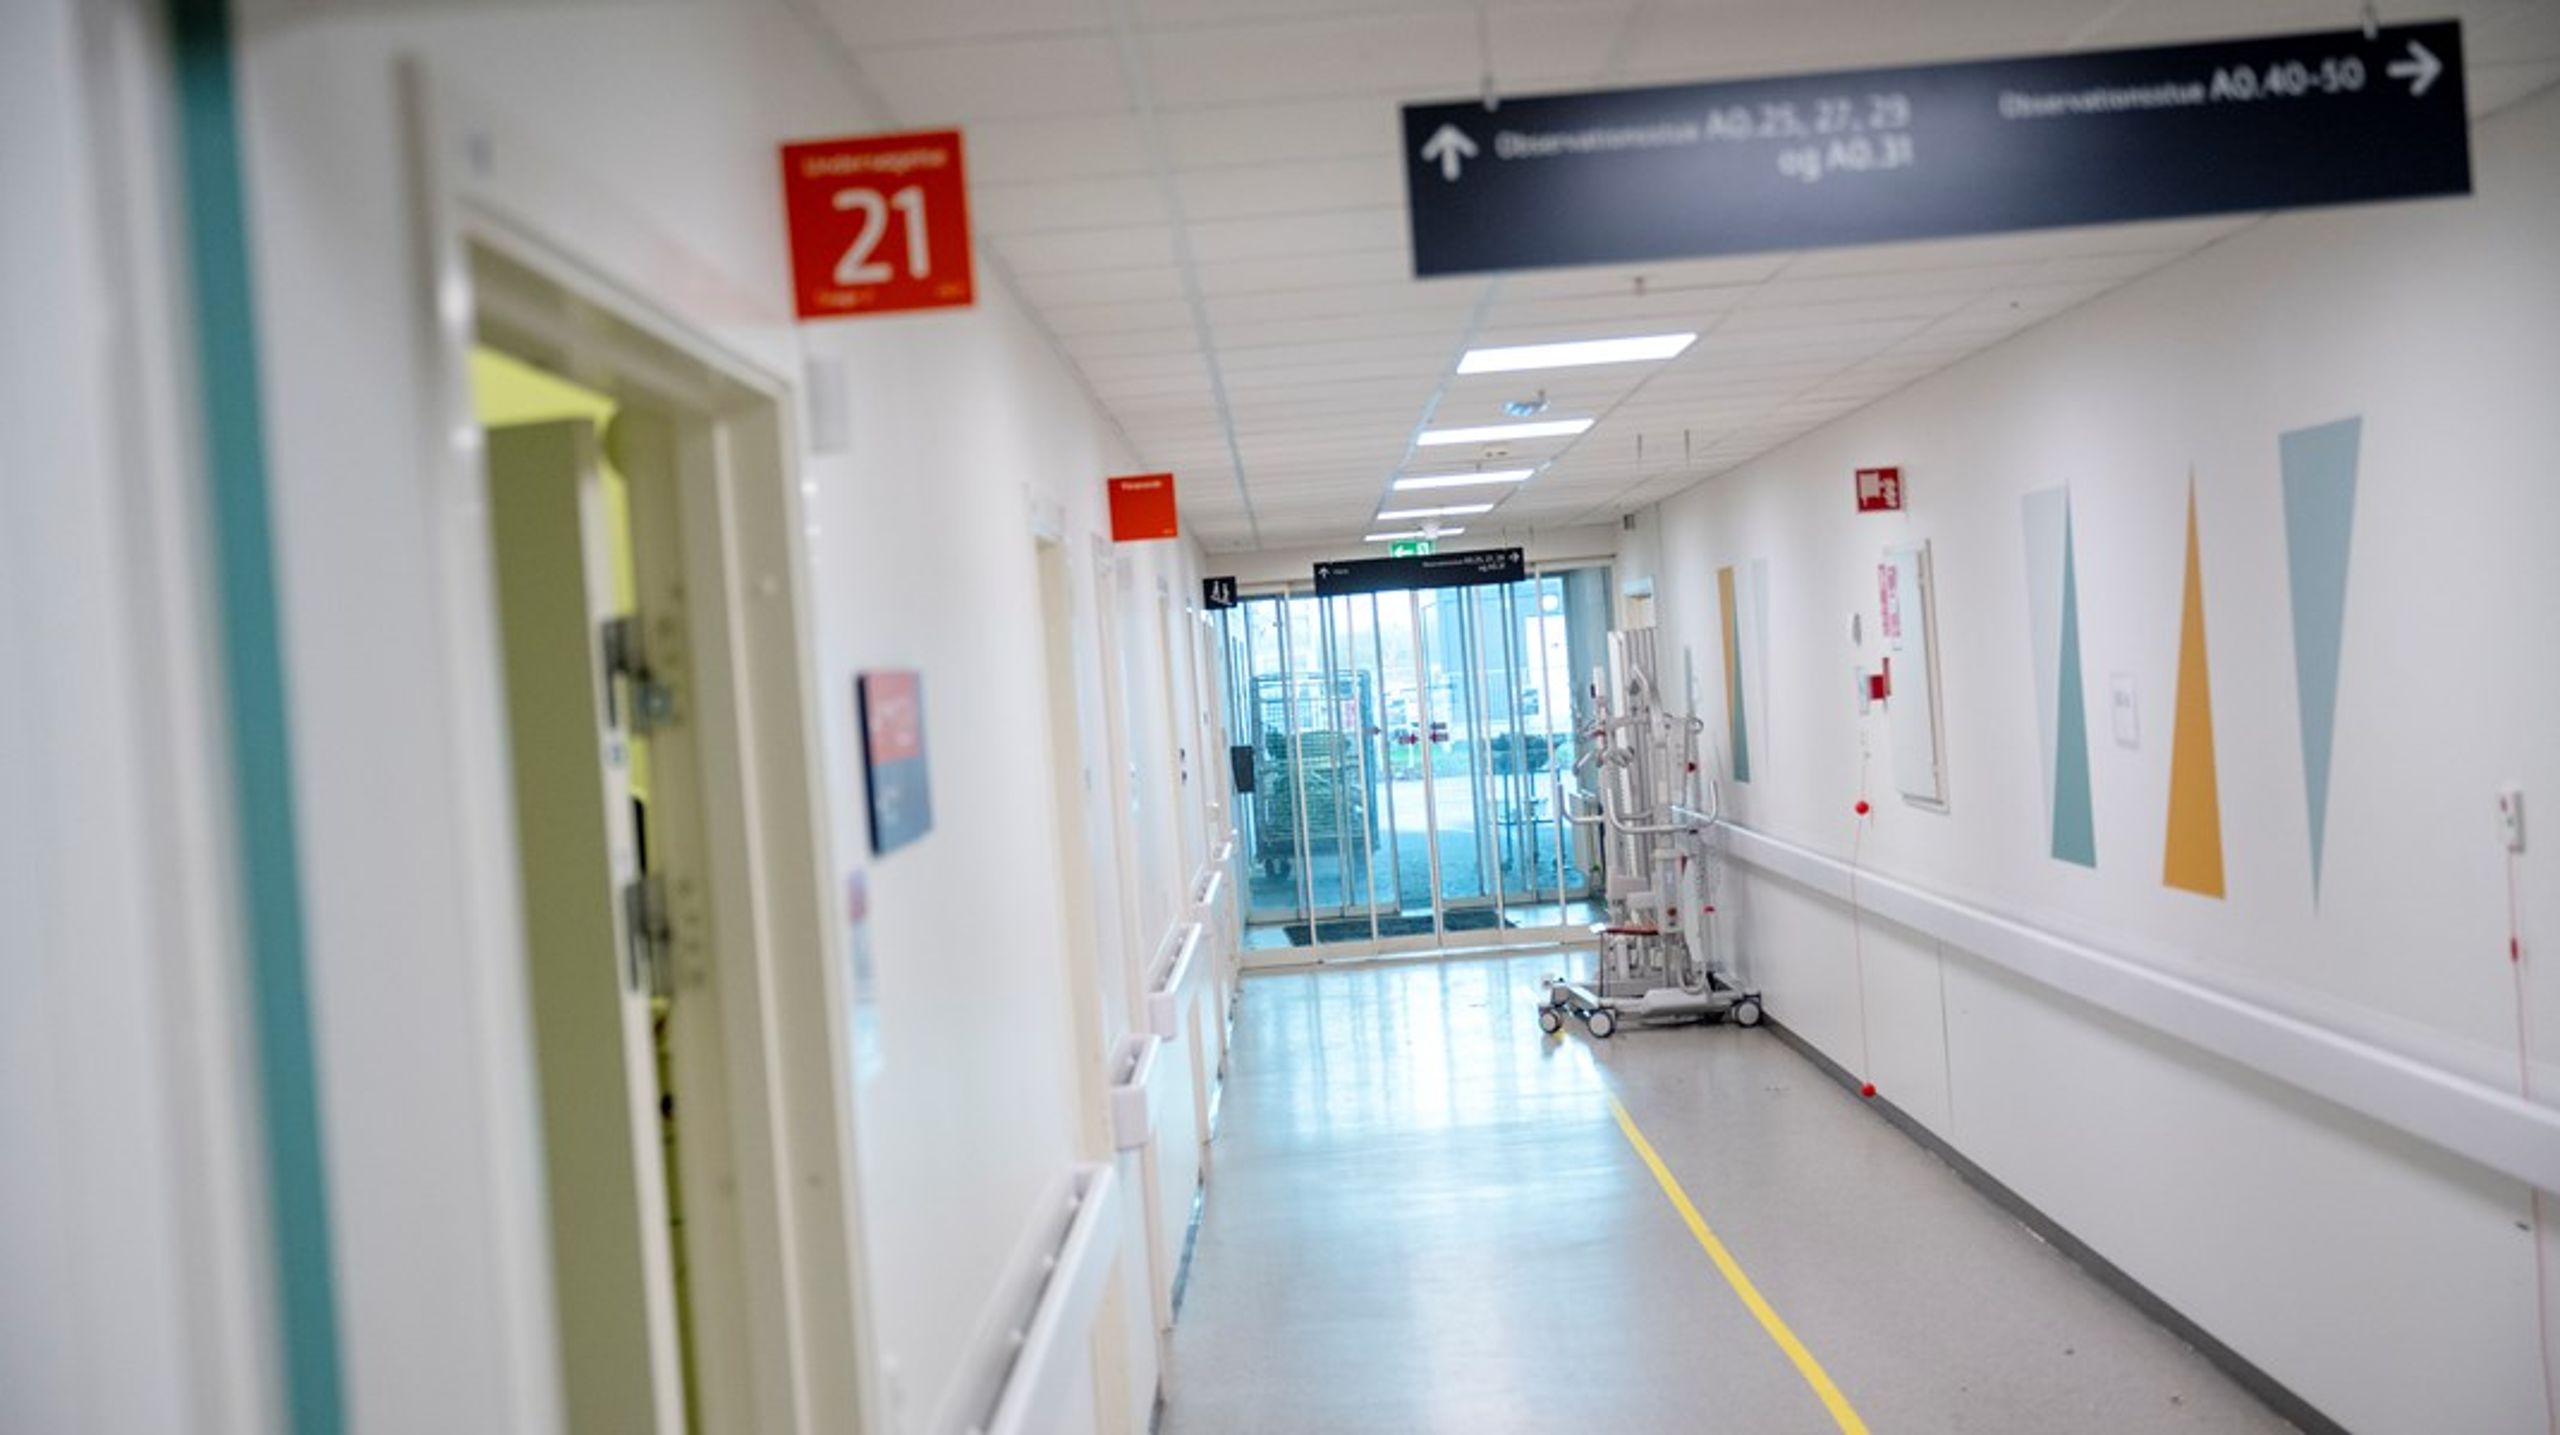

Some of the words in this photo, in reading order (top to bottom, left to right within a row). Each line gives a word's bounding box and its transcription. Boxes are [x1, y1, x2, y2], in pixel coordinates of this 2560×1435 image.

[2209, 56, 2366, 101] A0.40-50
[1868, 93, 1911, 130] 29
[1777, 147, 1822, 184] og
[832, 186, 931, 286] 21
